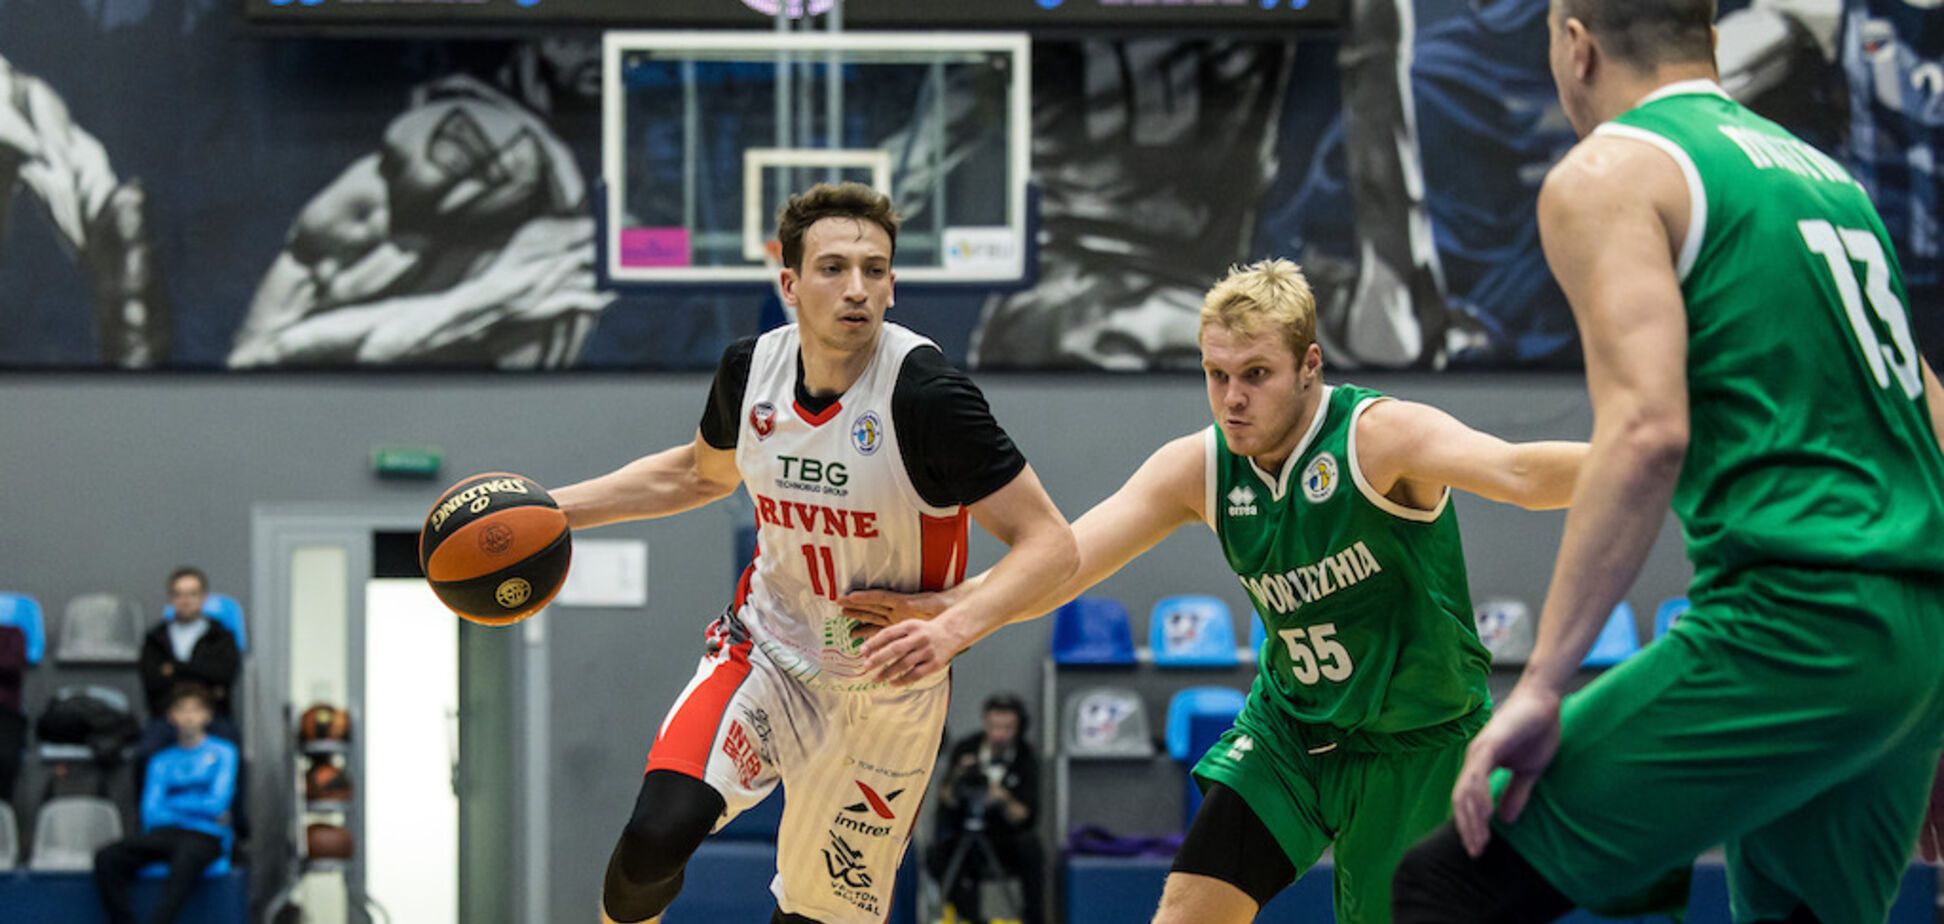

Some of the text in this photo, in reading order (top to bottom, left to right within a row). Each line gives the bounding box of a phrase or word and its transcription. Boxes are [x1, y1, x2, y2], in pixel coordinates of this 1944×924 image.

[1797, 218, 1923, 400] 13
[778, 455, 849, 486] TBG
[823, 485, 848, 497] GROUP
[431, 478, 528, 532] SPALDING
[757, 494, 879, 538] RIVNE
[801, 543, 838, 601] 11
[1278, 622, 1354, 685] 55
[728, 719, 762, 778] INTER
[834, 811, 893, 837] imtrex
